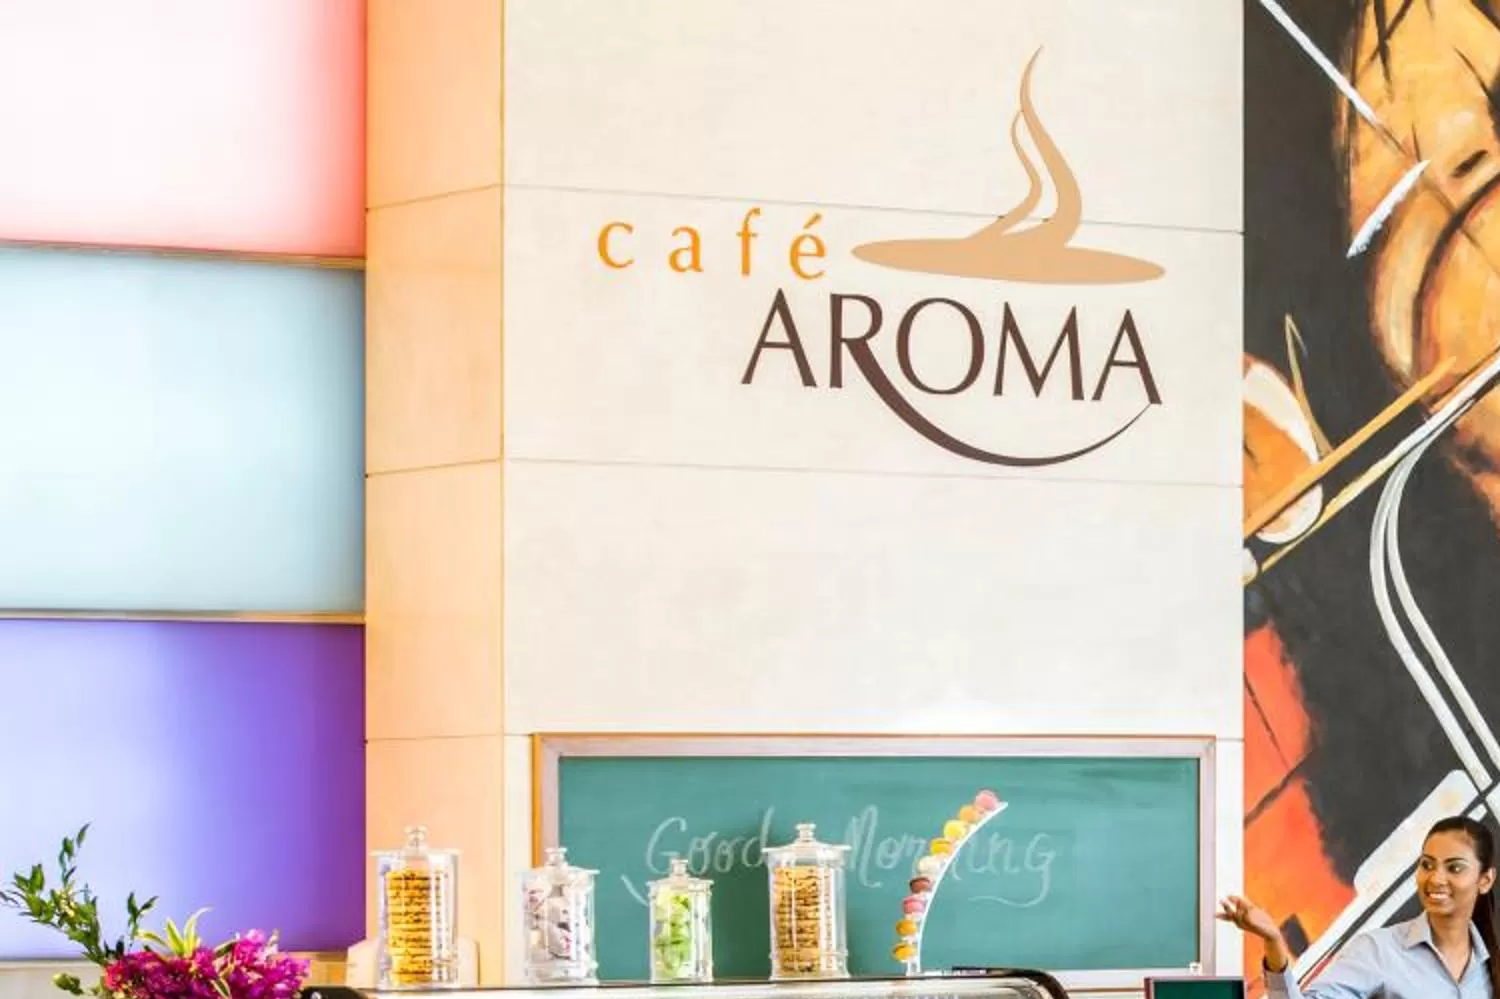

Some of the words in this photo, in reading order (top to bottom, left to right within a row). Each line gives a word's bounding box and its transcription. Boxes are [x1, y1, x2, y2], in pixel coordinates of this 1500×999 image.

[597, 207, 828, 281] café
[741, 288, 1163, 468] AROMA
[645, 805, 776, 877] Good
[844, 804, 1057, 909] Moring
